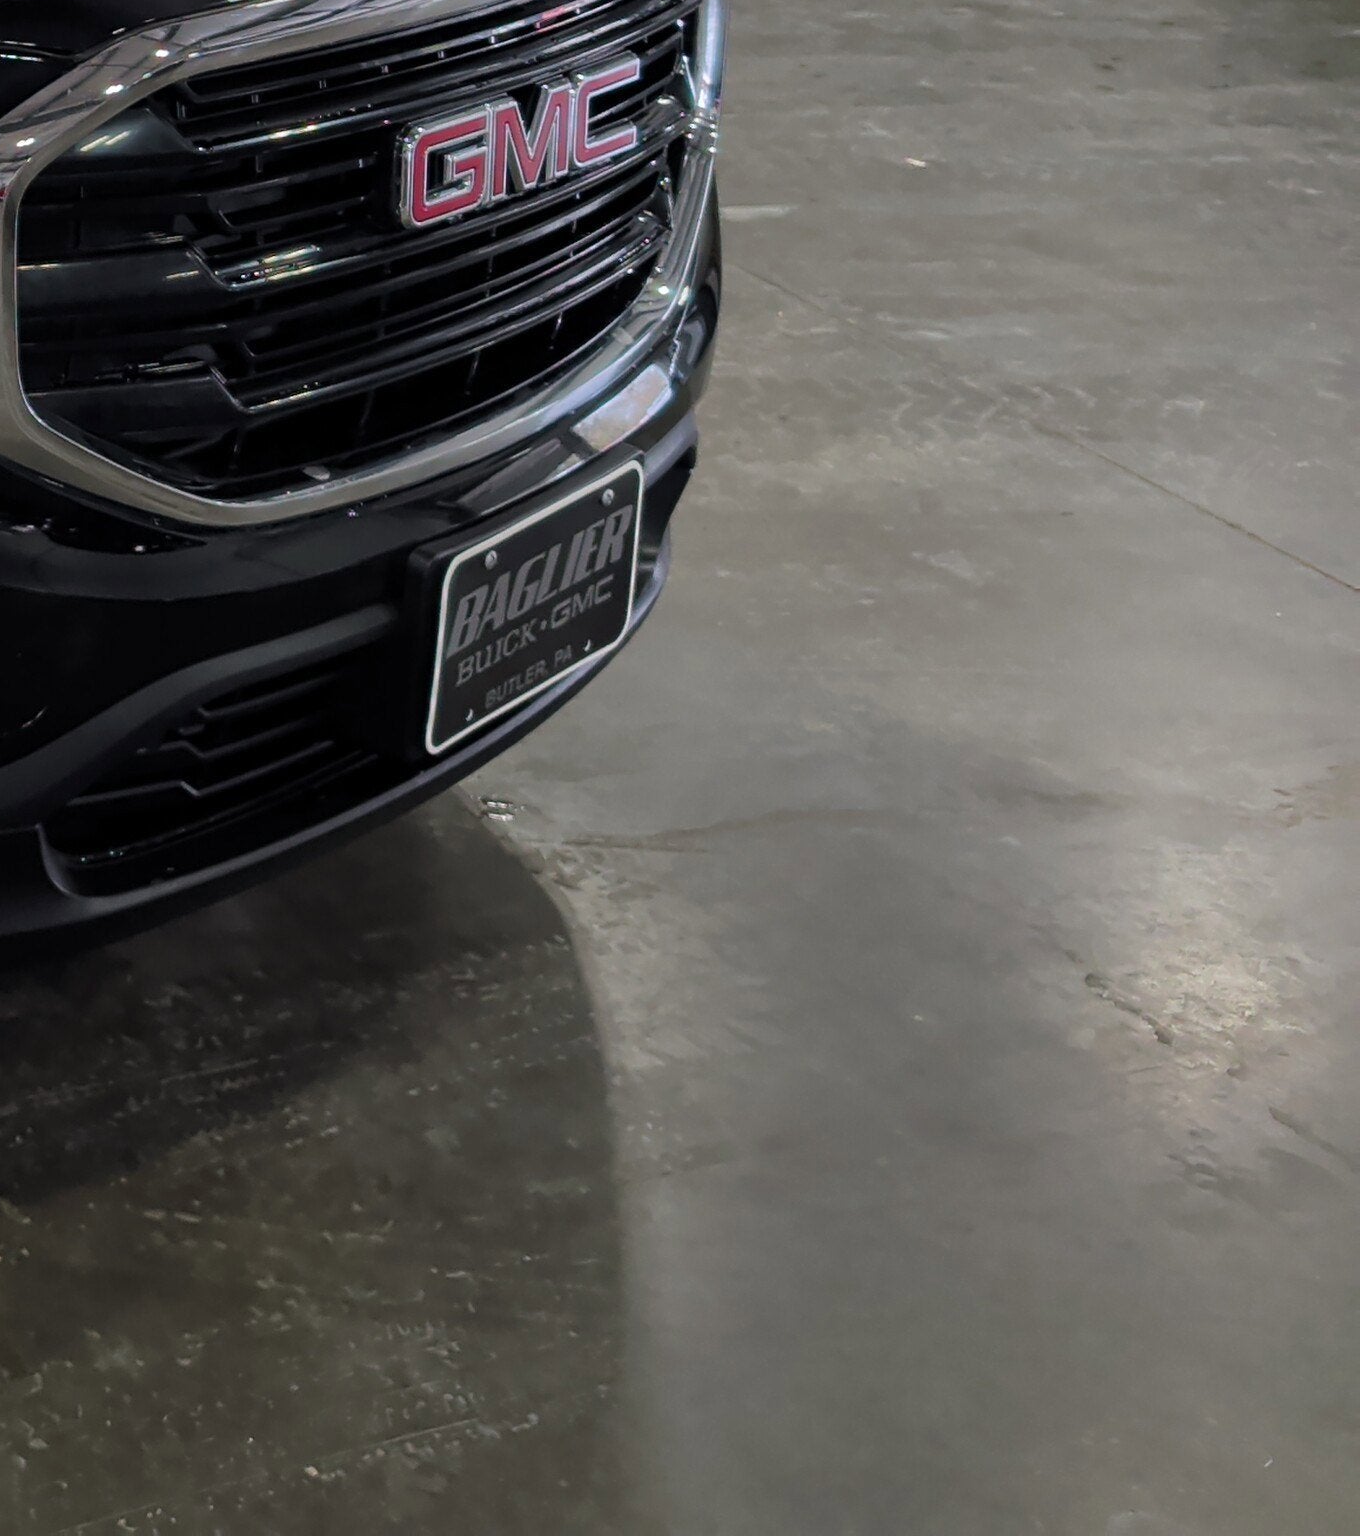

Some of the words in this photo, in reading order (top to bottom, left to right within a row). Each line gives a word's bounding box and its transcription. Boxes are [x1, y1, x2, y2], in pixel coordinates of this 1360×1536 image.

[396, 50, 641, 230] GMC
[445, 504, 633, 659] BAGLIER
[455, 619, 537, 687] BUICK
[550, 575, 614, 631] GMC
[554, 645, 573, 667] PA
